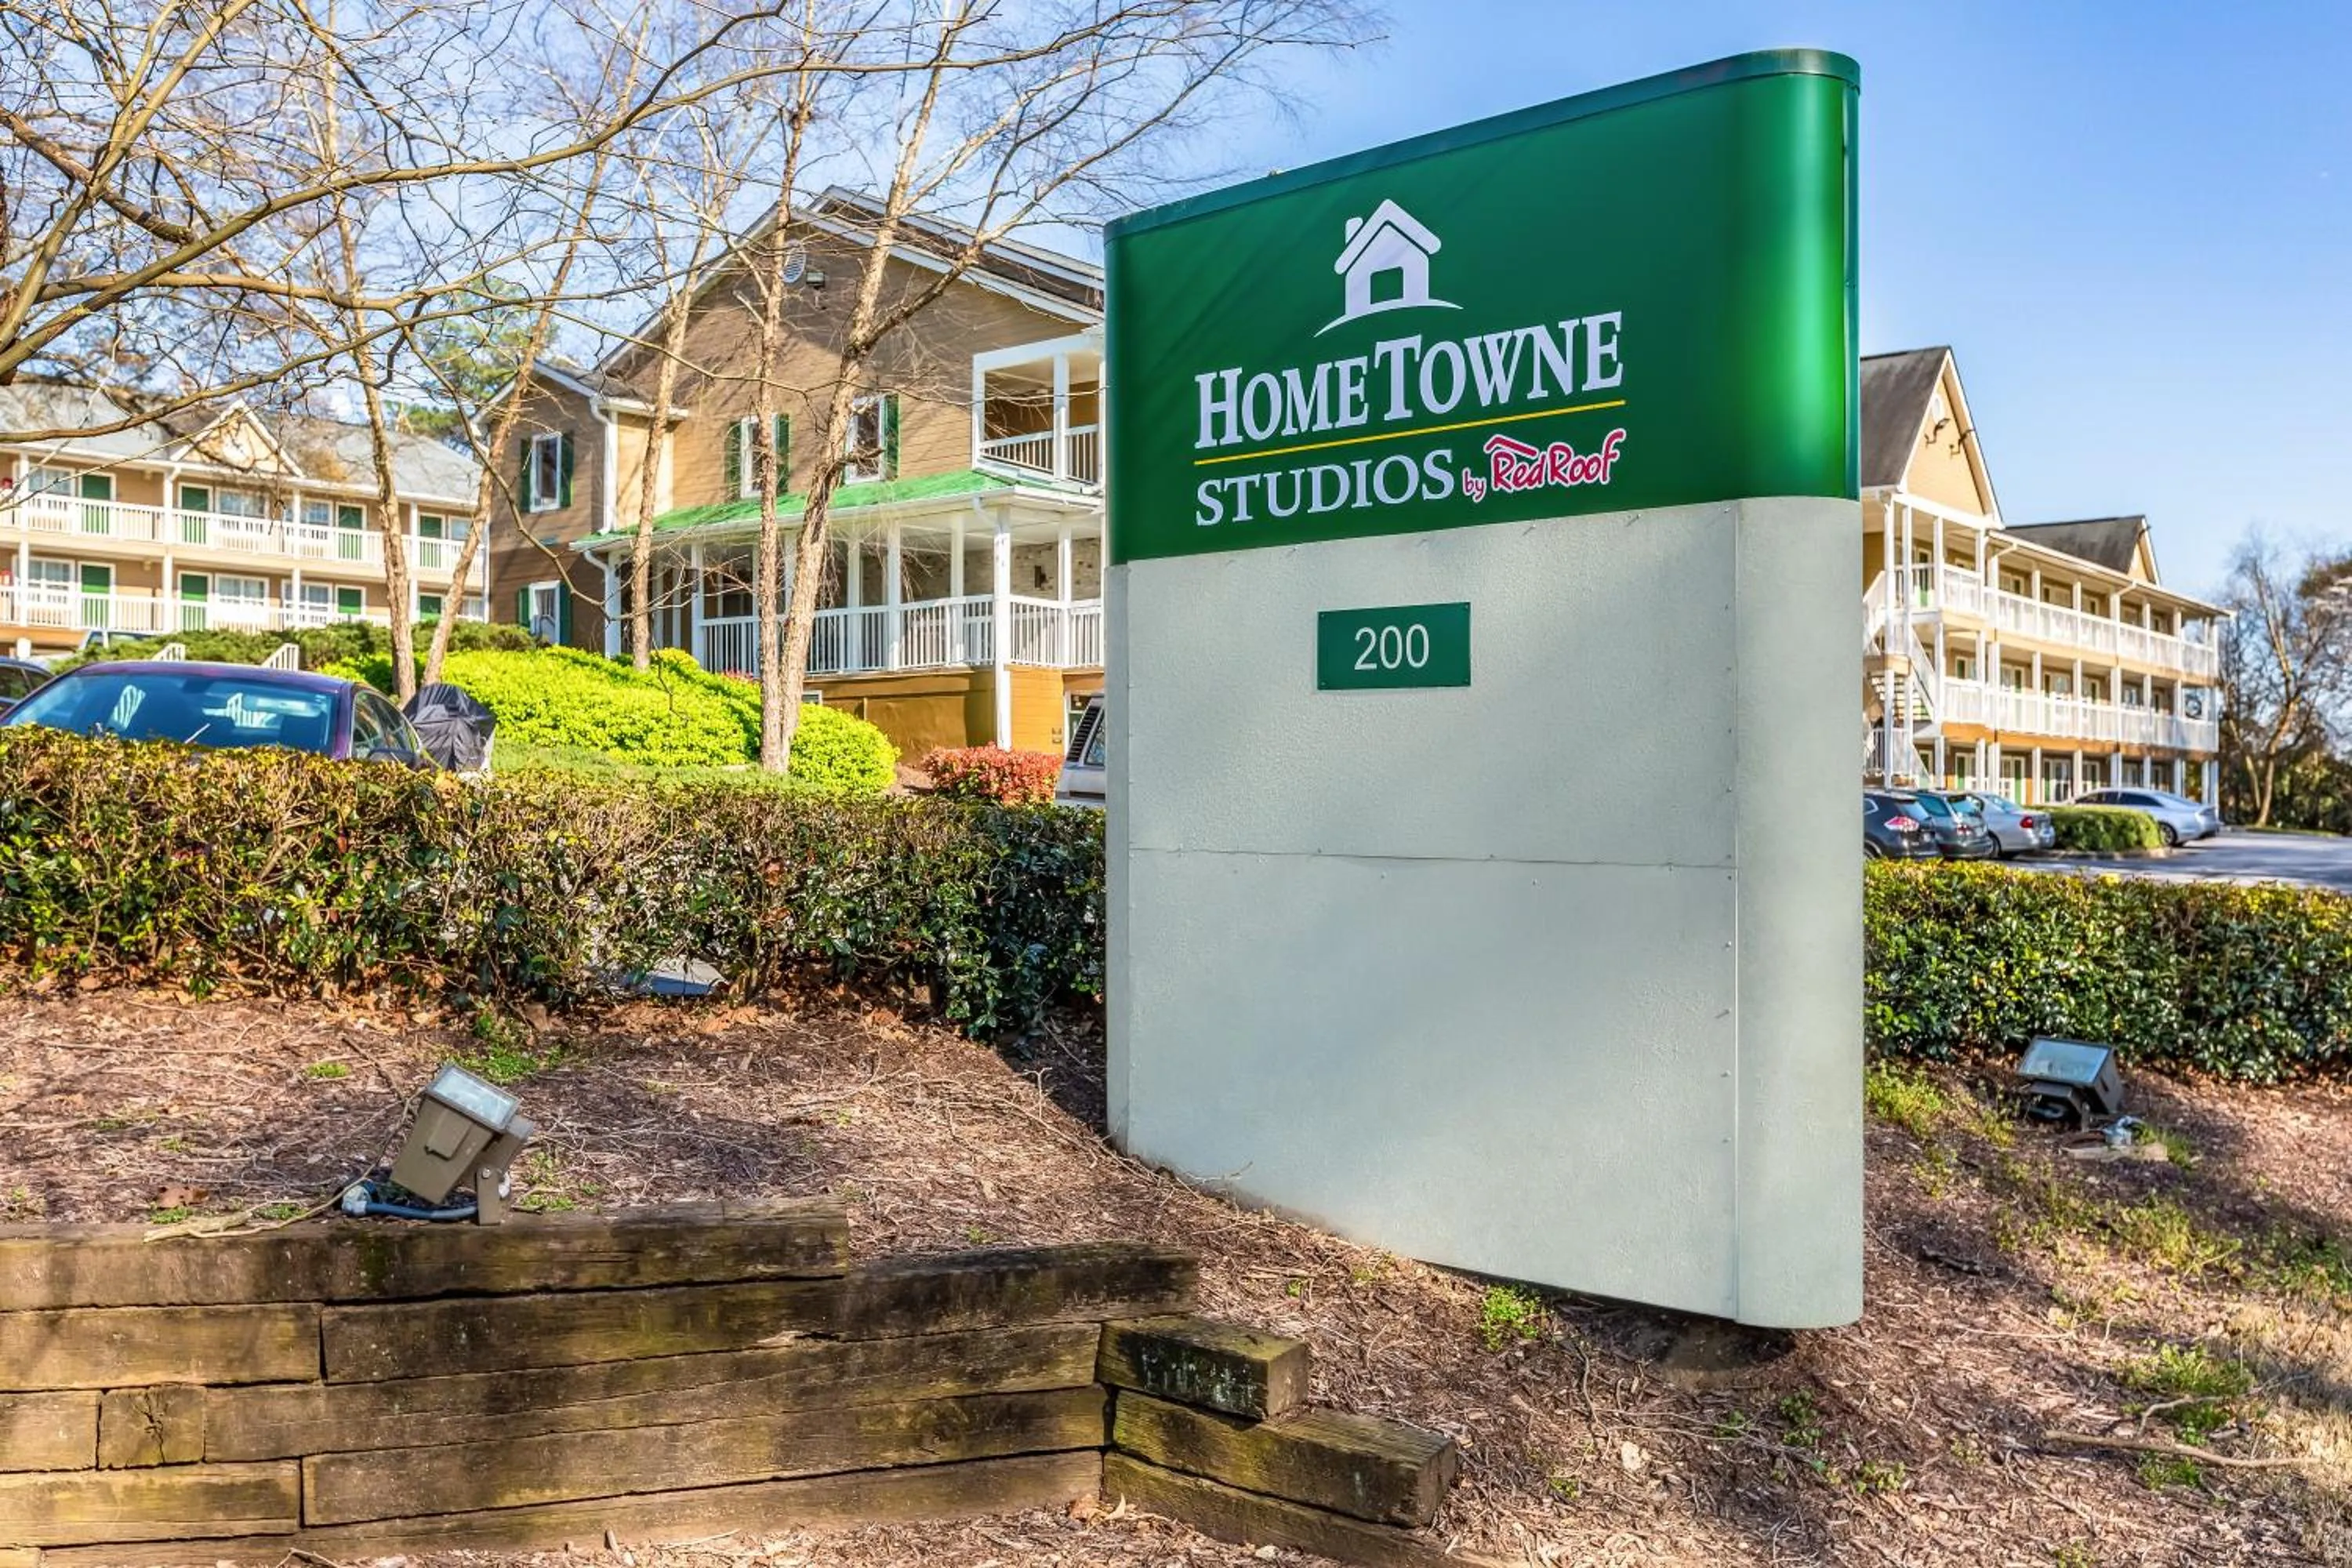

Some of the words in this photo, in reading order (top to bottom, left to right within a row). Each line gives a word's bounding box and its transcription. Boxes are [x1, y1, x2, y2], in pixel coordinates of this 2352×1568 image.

[1196, 448, 1455, 527] STUDIOS
[1462, 467, 1486, 503] by
[1353, 623, 1430, 670] 200
